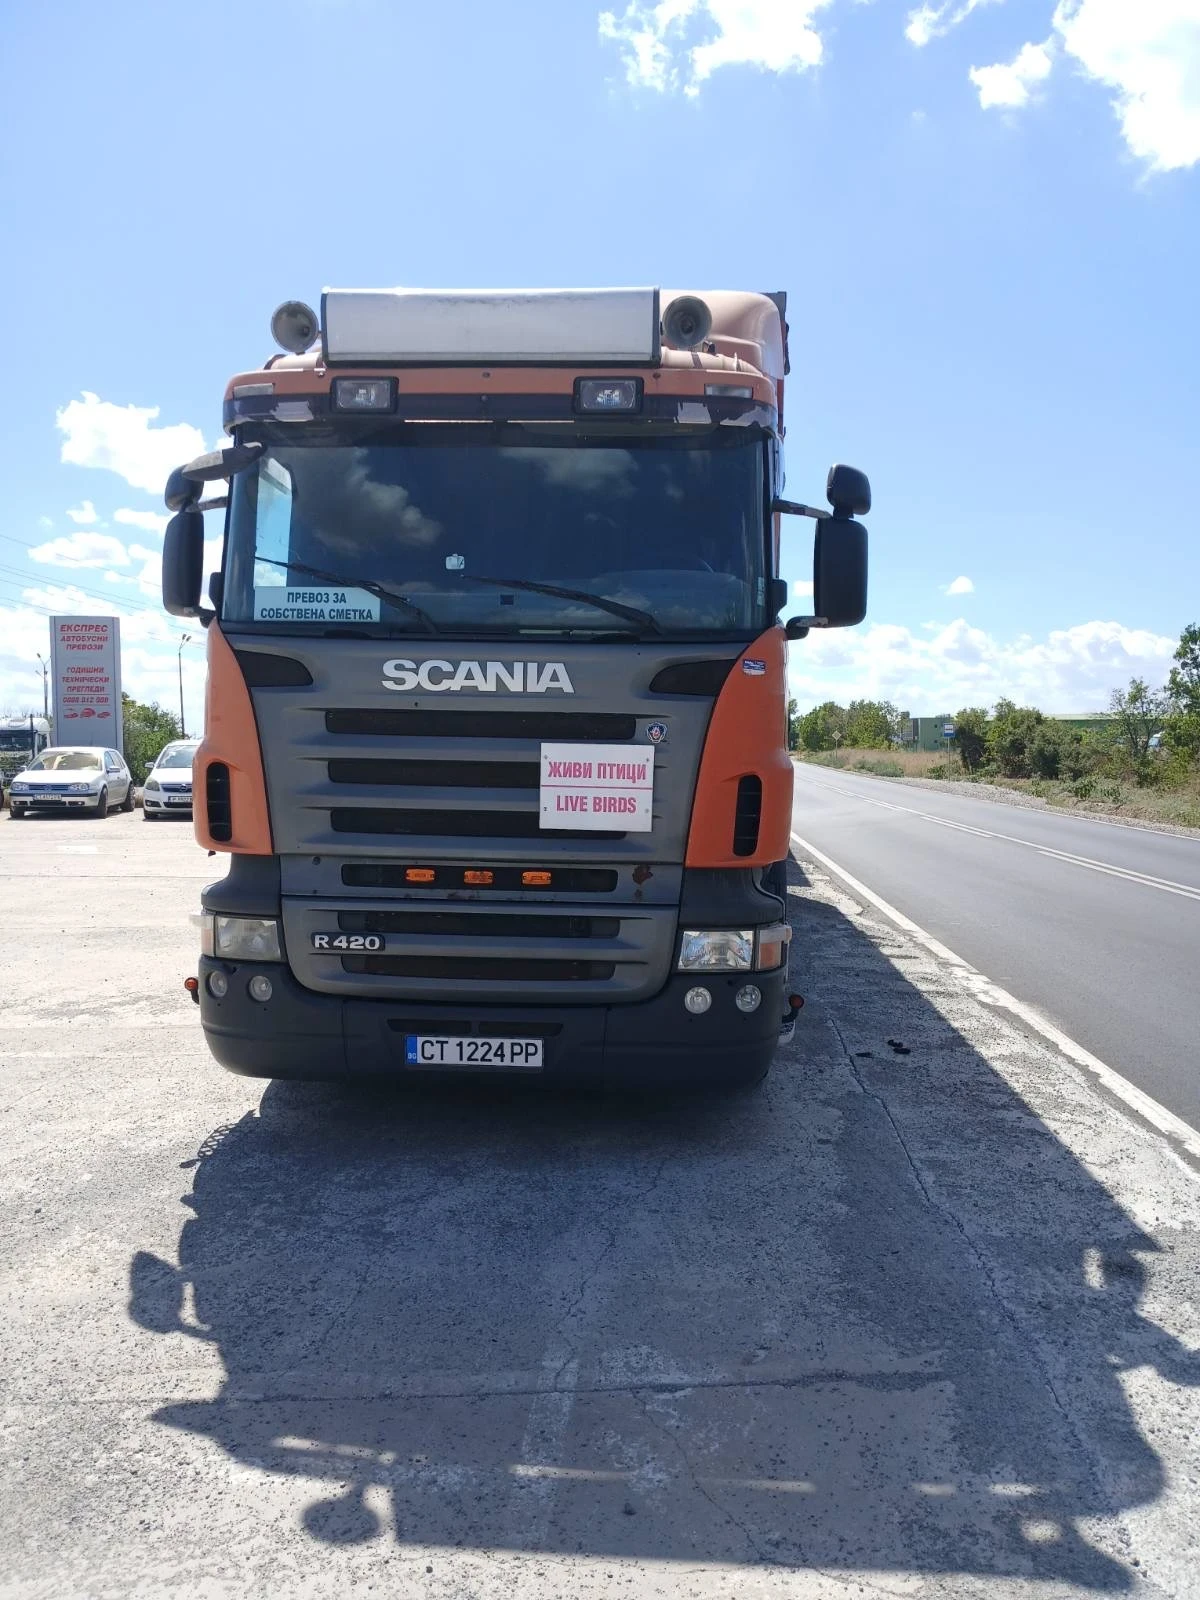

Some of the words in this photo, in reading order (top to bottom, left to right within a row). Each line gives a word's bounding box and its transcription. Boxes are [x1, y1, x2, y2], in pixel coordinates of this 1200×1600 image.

[287, 592, 330, 604] ПРЕВОЗ
[333, 592, 347, 604] ЗА
[260, 608, 326, 619] СОБСТВЕНА
[328, 608, 373, 620] СМЕТКА
[60, 624, 108, 633] ЕКСПРЕС
[381, 658, 575, 694] SCANIA
[547, 761, 592, 779] ЖИВИ
[596, 763, 647, 784] ПТИЦИ
[556, 795, 588, 812] LIVE
[592, 796, 637, 813] BIRDS
[314, 934, 330, 949] R
[332, 935, 380, 950] 420
[420, 1039, 449, 1061] CT
[455, 1040, 506, 1063] 1224
